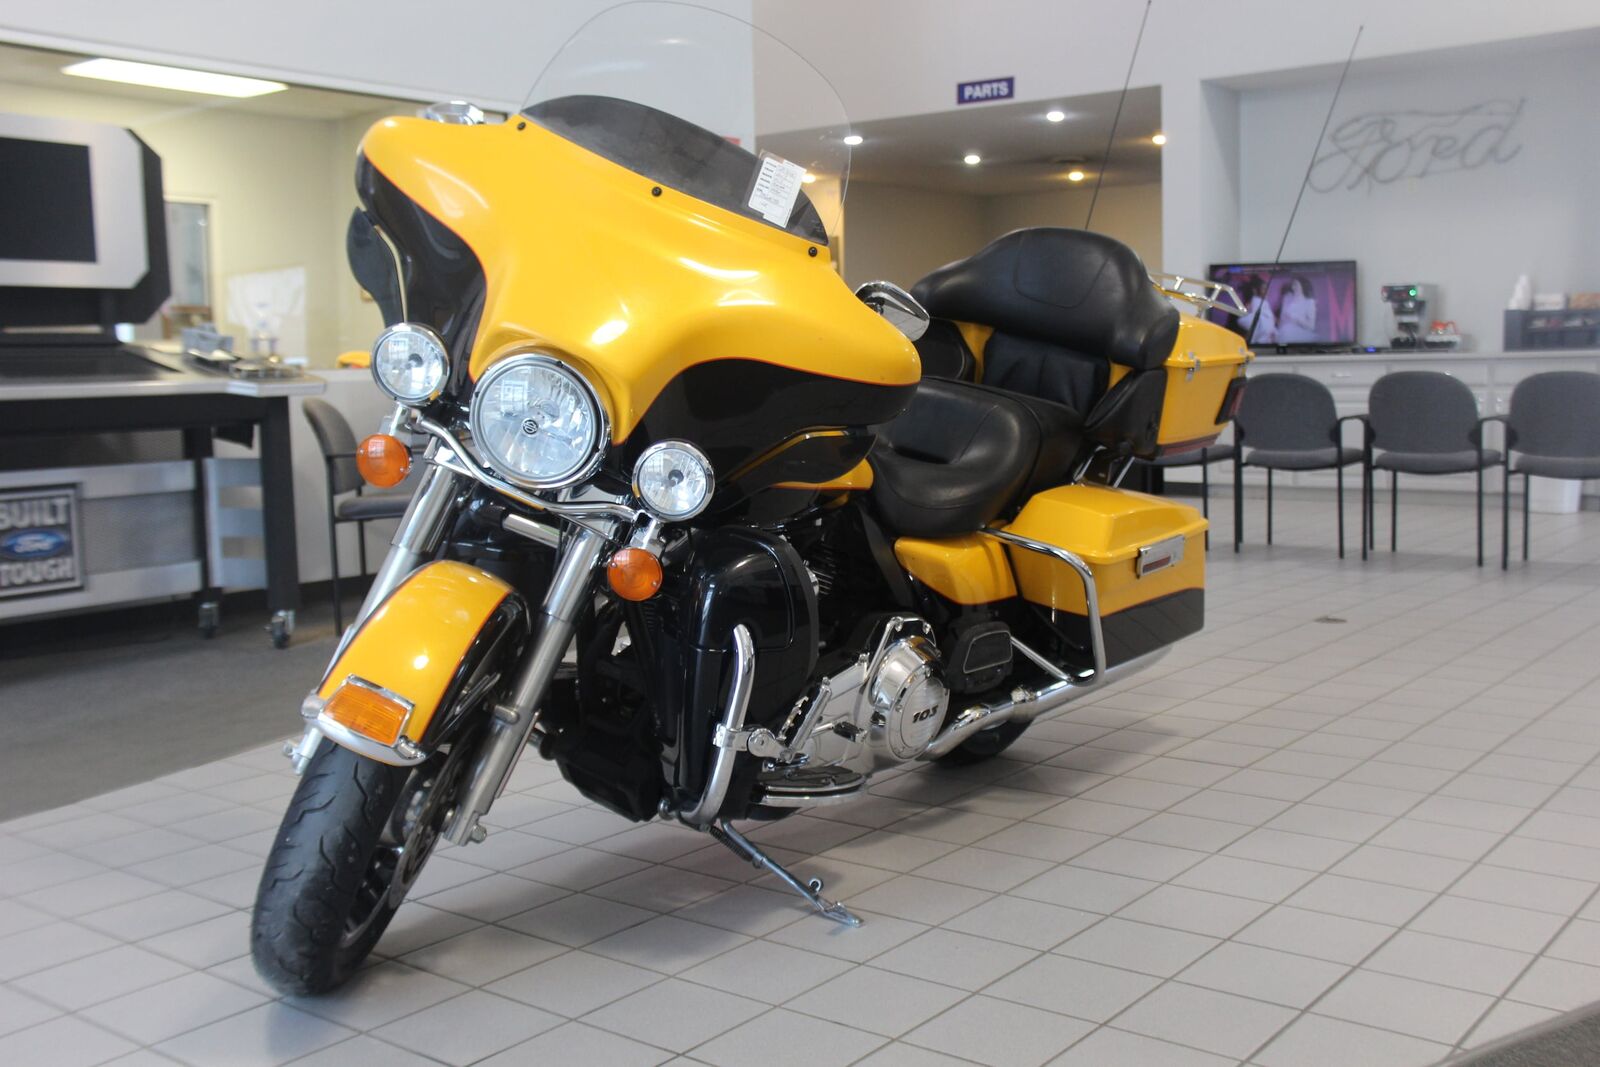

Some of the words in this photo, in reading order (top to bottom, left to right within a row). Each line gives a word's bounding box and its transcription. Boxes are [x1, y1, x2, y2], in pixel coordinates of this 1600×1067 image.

[963, 80, 1009, 100] PARTS
[1307, 97, 1525, 196] Ford
[0, 557, 73, 586] TOUGH
